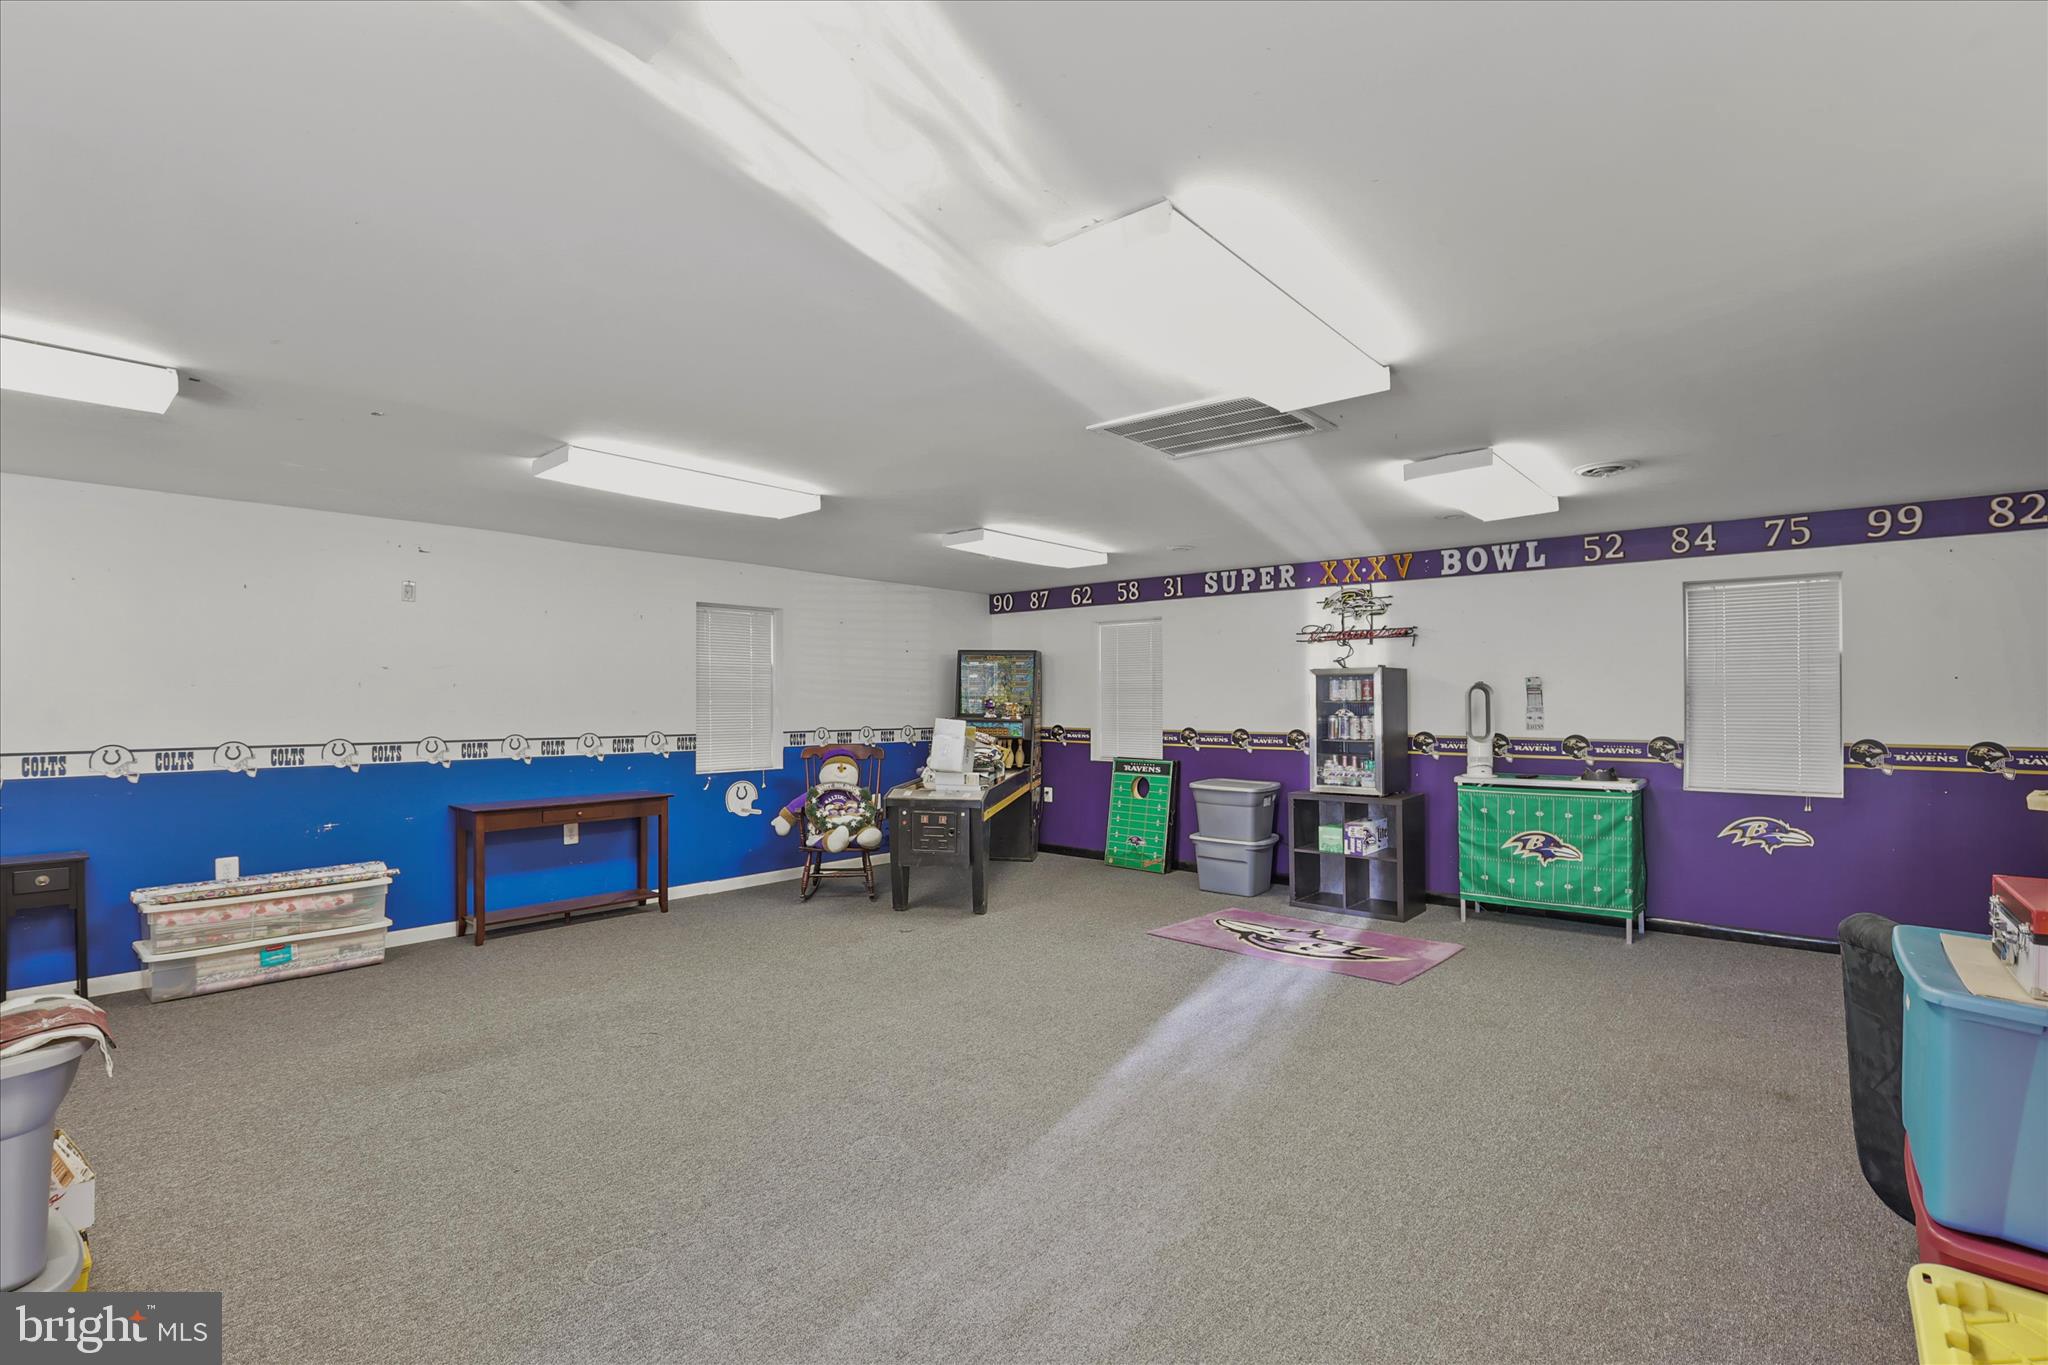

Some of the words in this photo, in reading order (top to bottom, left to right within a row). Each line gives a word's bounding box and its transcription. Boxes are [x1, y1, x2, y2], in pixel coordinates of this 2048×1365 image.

[993, 594, 1013, 612] 90
[1029, 591, 1049, 609] 87
[1071, 587, 1092, 605] 62
[1117, 582, 1139, 602] 58
[1163, 577, 1184, 598] 31
[1204, 564, 1297, 594] SUPER
[1319, 554, 1414, 585] XXXV
[1440, 541, 1547, 577] BOWL
[1584, 533, 1625, 562] 52
[1671, 524, 1717, 554] 84
[1764, 516, 1811, 547] 75
[1867, 505, 1924, 538] 99
[1988, 493, 2048, 528] 82
[1594, 747, 1642, 755] RAVENS
[21, 756, 67, 778] COLTS
[155, 751, 195, 771] COLTS
[270, 748, 305, 766] COLTS
[372, 745, 402, 762] COLTS
[461, 742, 488, 759] COLTS
[541, 740, 565, 756] COLTS
[612, 738, 634, 753] COLTS
[676, 736, 697, 751] COLTS
[1894, 754, 1959, 763] RAVENS
[2016, 757, 2048, 766] RAV
[1123, 764, 1162, 773] RAVENS
